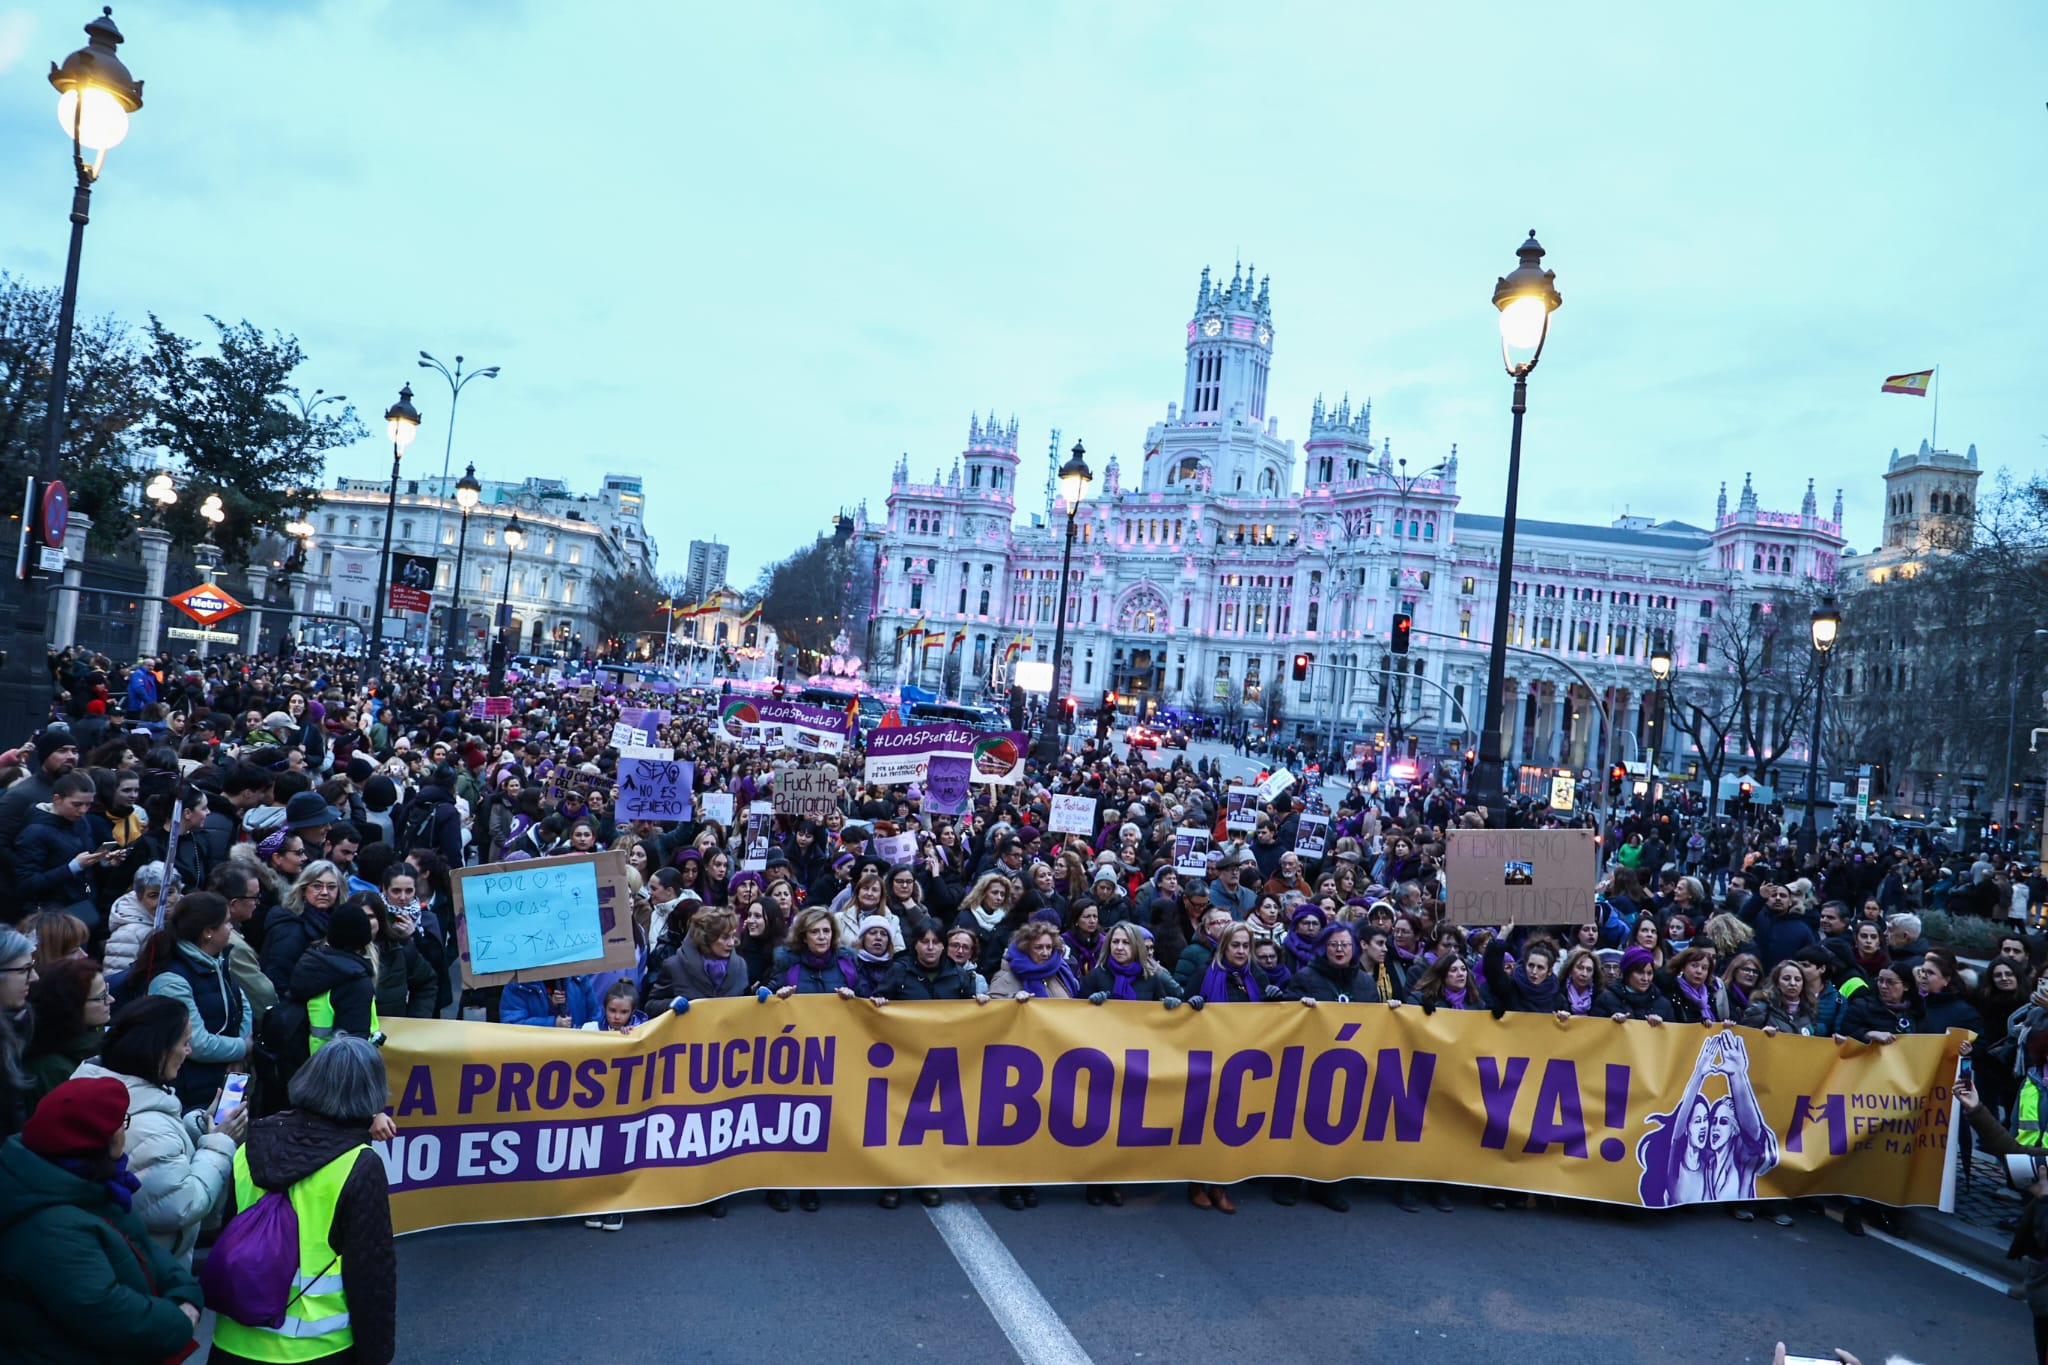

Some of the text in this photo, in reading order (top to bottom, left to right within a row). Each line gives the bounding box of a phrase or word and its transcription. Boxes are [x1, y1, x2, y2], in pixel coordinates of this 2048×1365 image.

[190, 597, 223, 610] Metro
[171, 629, 195, 639] Banco
[640, 784, 677, 799] NO ES
[784, 771, 838, 793] Fuck the
[774, 792, 837, 816] Patriarchy
[1456, 832, 1567, 862] FEMINISMO
[477, 899, 551, 919] LOCAS
[384, 1024, 836, 1117] A PROSTITUCIÓN
[863, 1023, 1630, 1162] ¡ABOLICIÓN YA!
[1851, 1086, 1947, 1111] MOVIMIEO
[1854, 1108, 1949, 1136] FEMINTA
[371, 1102, 821, 1185] NO ES UN TRABAJO
[1886, 1132, 1948, 1156] MARID
